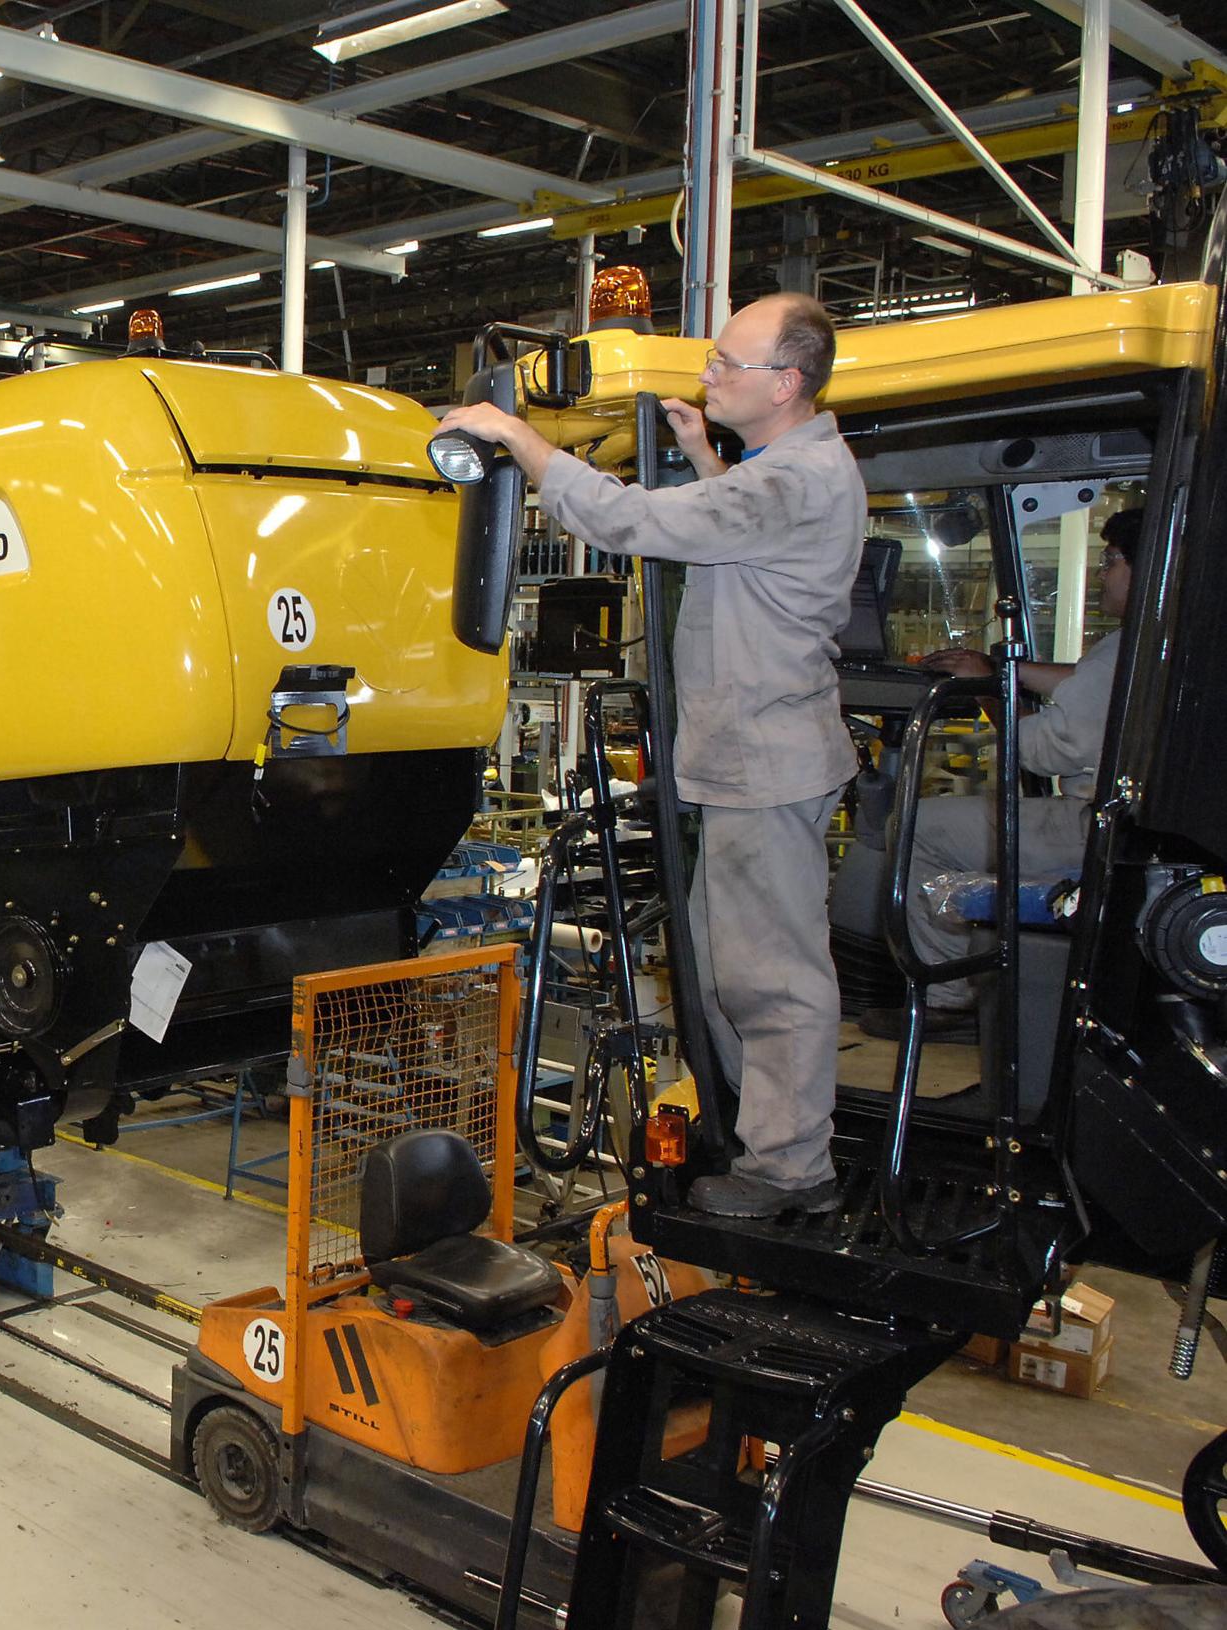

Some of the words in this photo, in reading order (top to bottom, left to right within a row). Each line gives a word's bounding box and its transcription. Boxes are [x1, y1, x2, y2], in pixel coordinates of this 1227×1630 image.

[868, 163, 889, 178] KG
[277, 595, 307, 643] 25
[254, 1324, 280, 1376] 25
[329, 1402, 380, 1431] STILL
